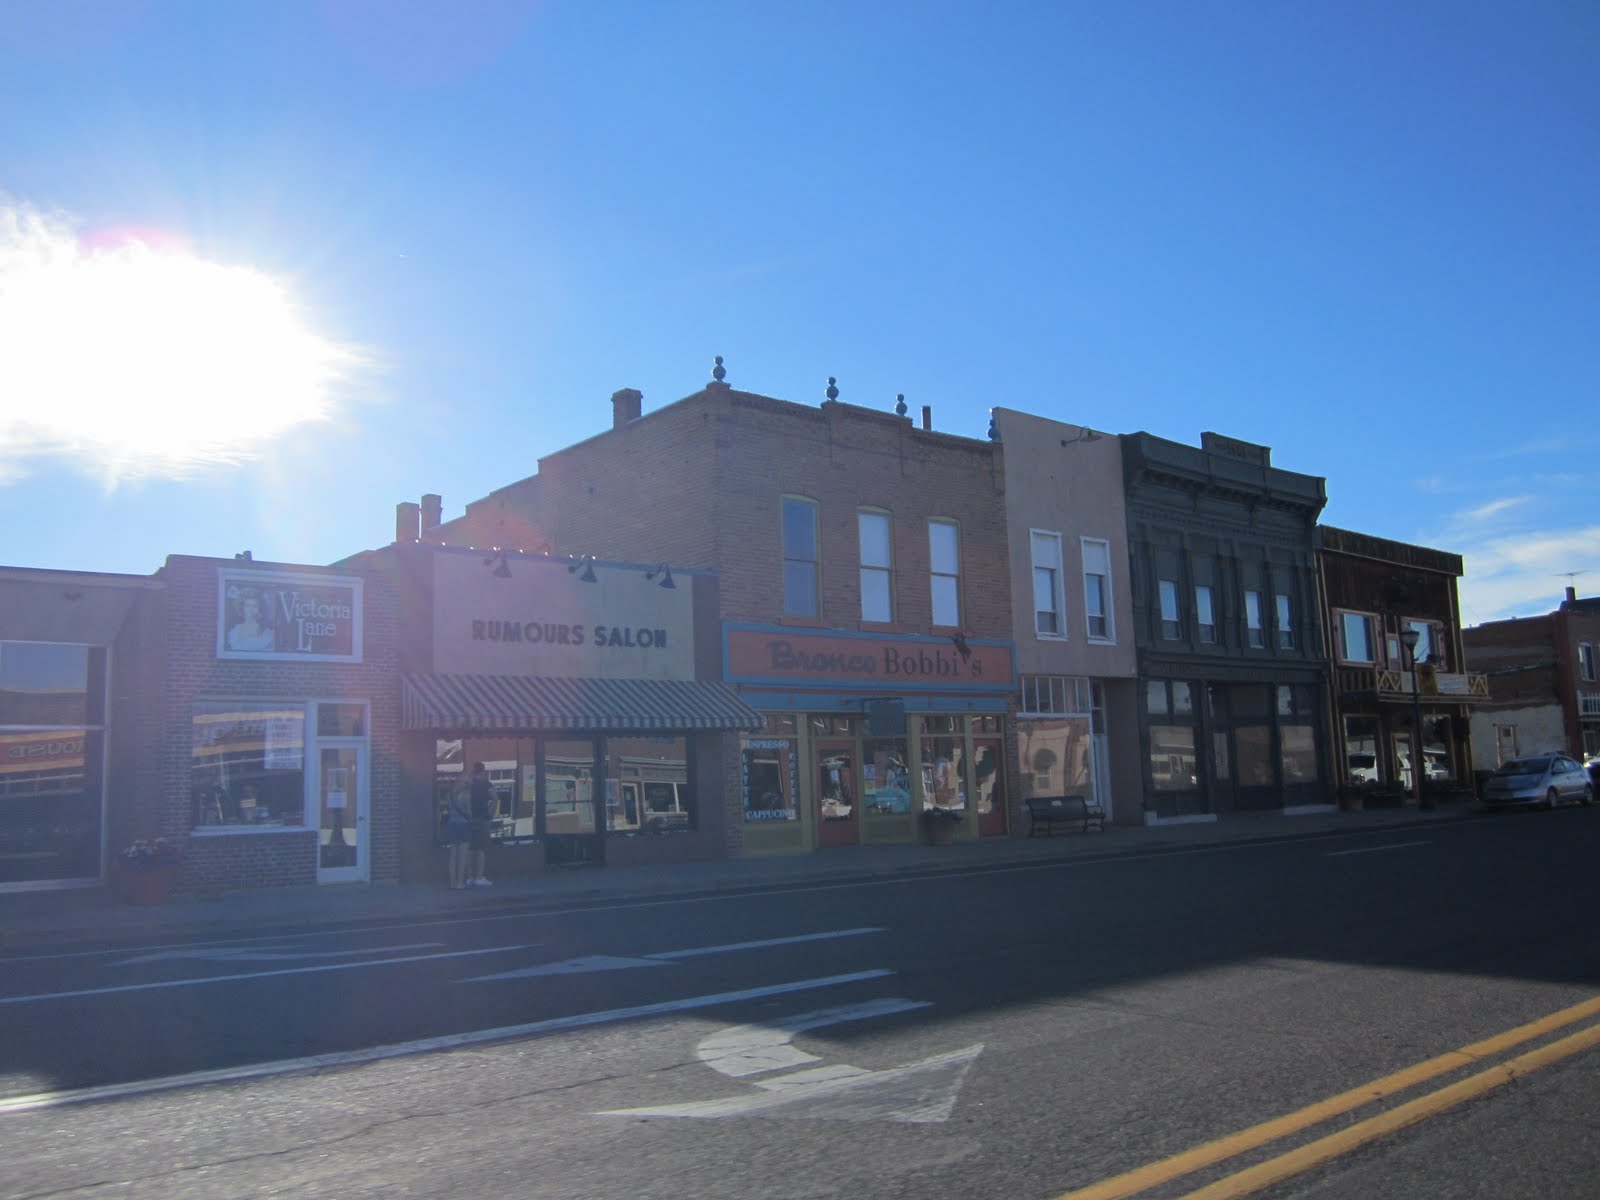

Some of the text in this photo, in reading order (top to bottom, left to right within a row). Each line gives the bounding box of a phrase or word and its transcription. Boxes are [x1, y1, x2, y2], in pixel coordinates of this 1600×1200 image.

[277, 591, 352, 623] Victoria
[295, 618, 337, 653] Lane
[472, 619, 667, 649] RUMOURS SALON
[768, 639, 983, 677] Bronco Bobbi's
[746, 740, 790, 749] ESPRESSO
[742, 753, 750, 807] LATTE
